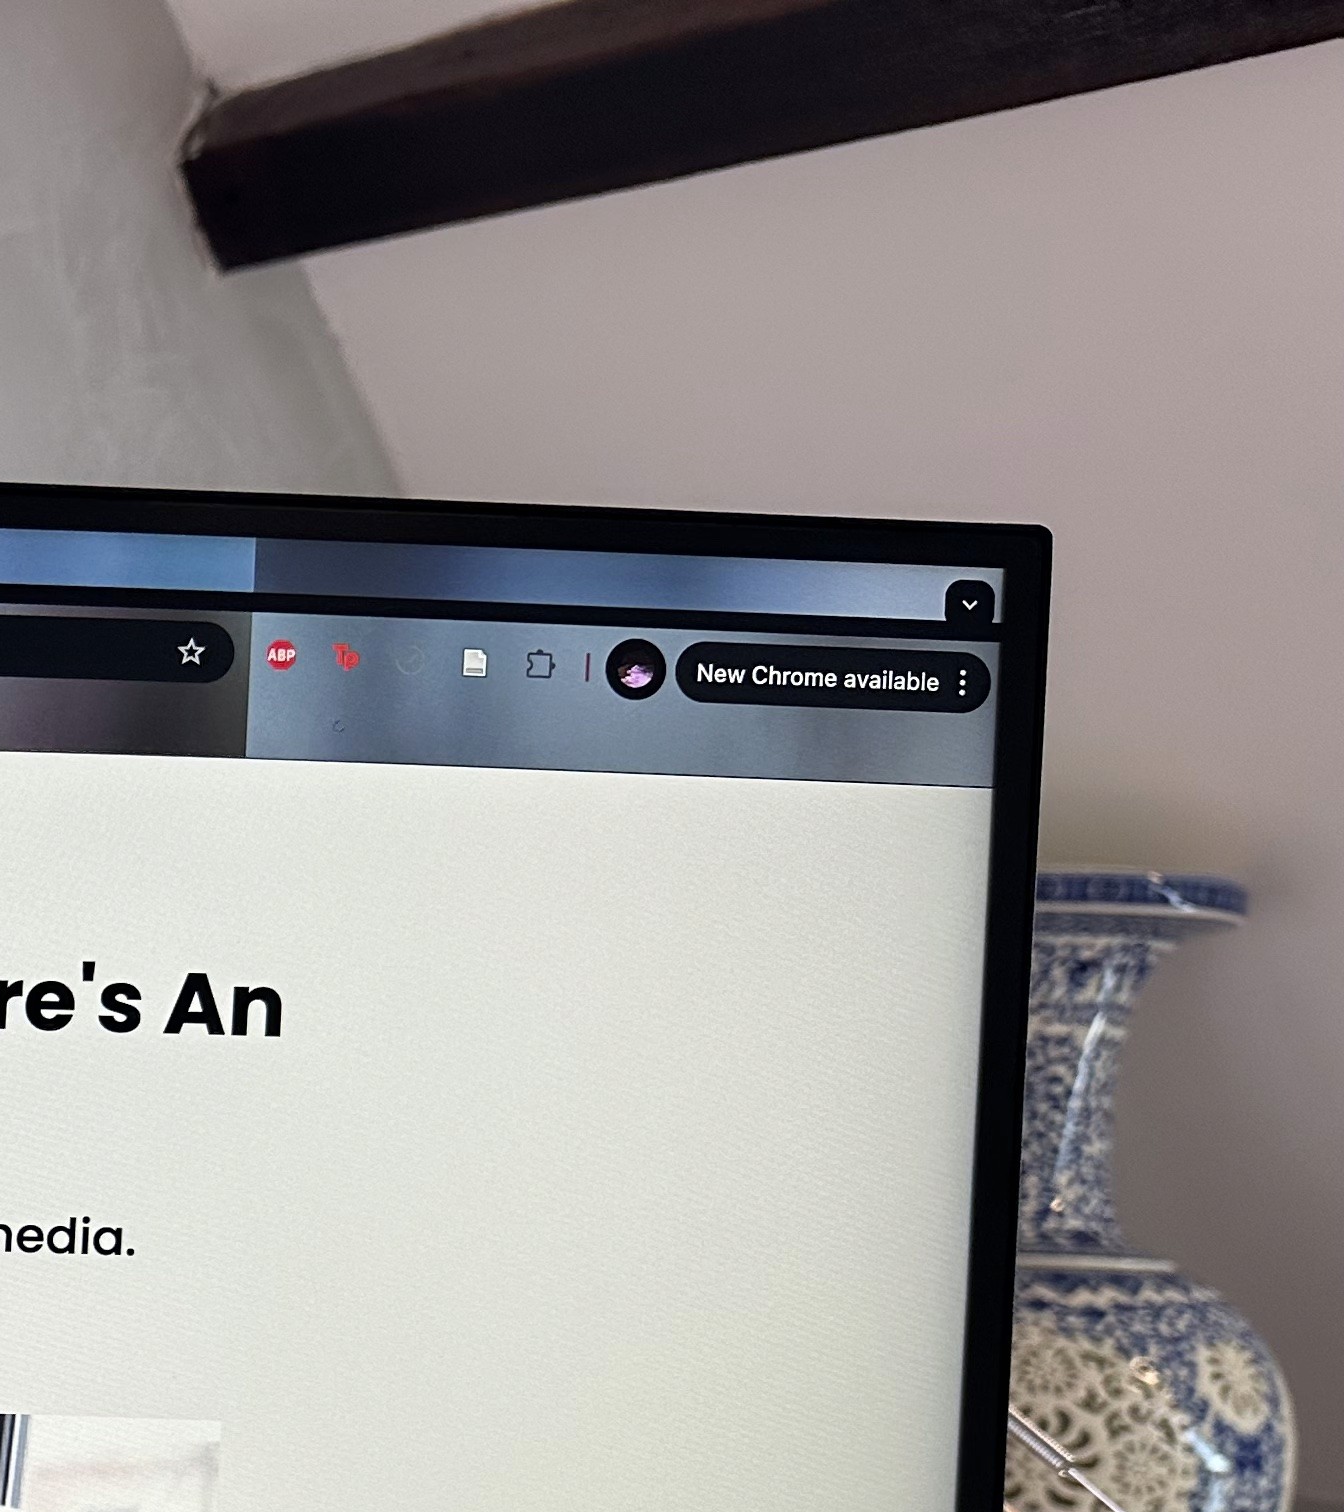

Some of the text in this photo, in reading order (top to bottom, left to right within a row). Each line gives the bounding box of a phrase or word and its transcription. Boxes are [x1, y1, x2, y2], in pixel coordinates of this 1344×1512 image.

[266, 648, 296, 663] ABP
[696, 662, 940, 692] New Chrome available
[162, 972, 282, 1038] An
